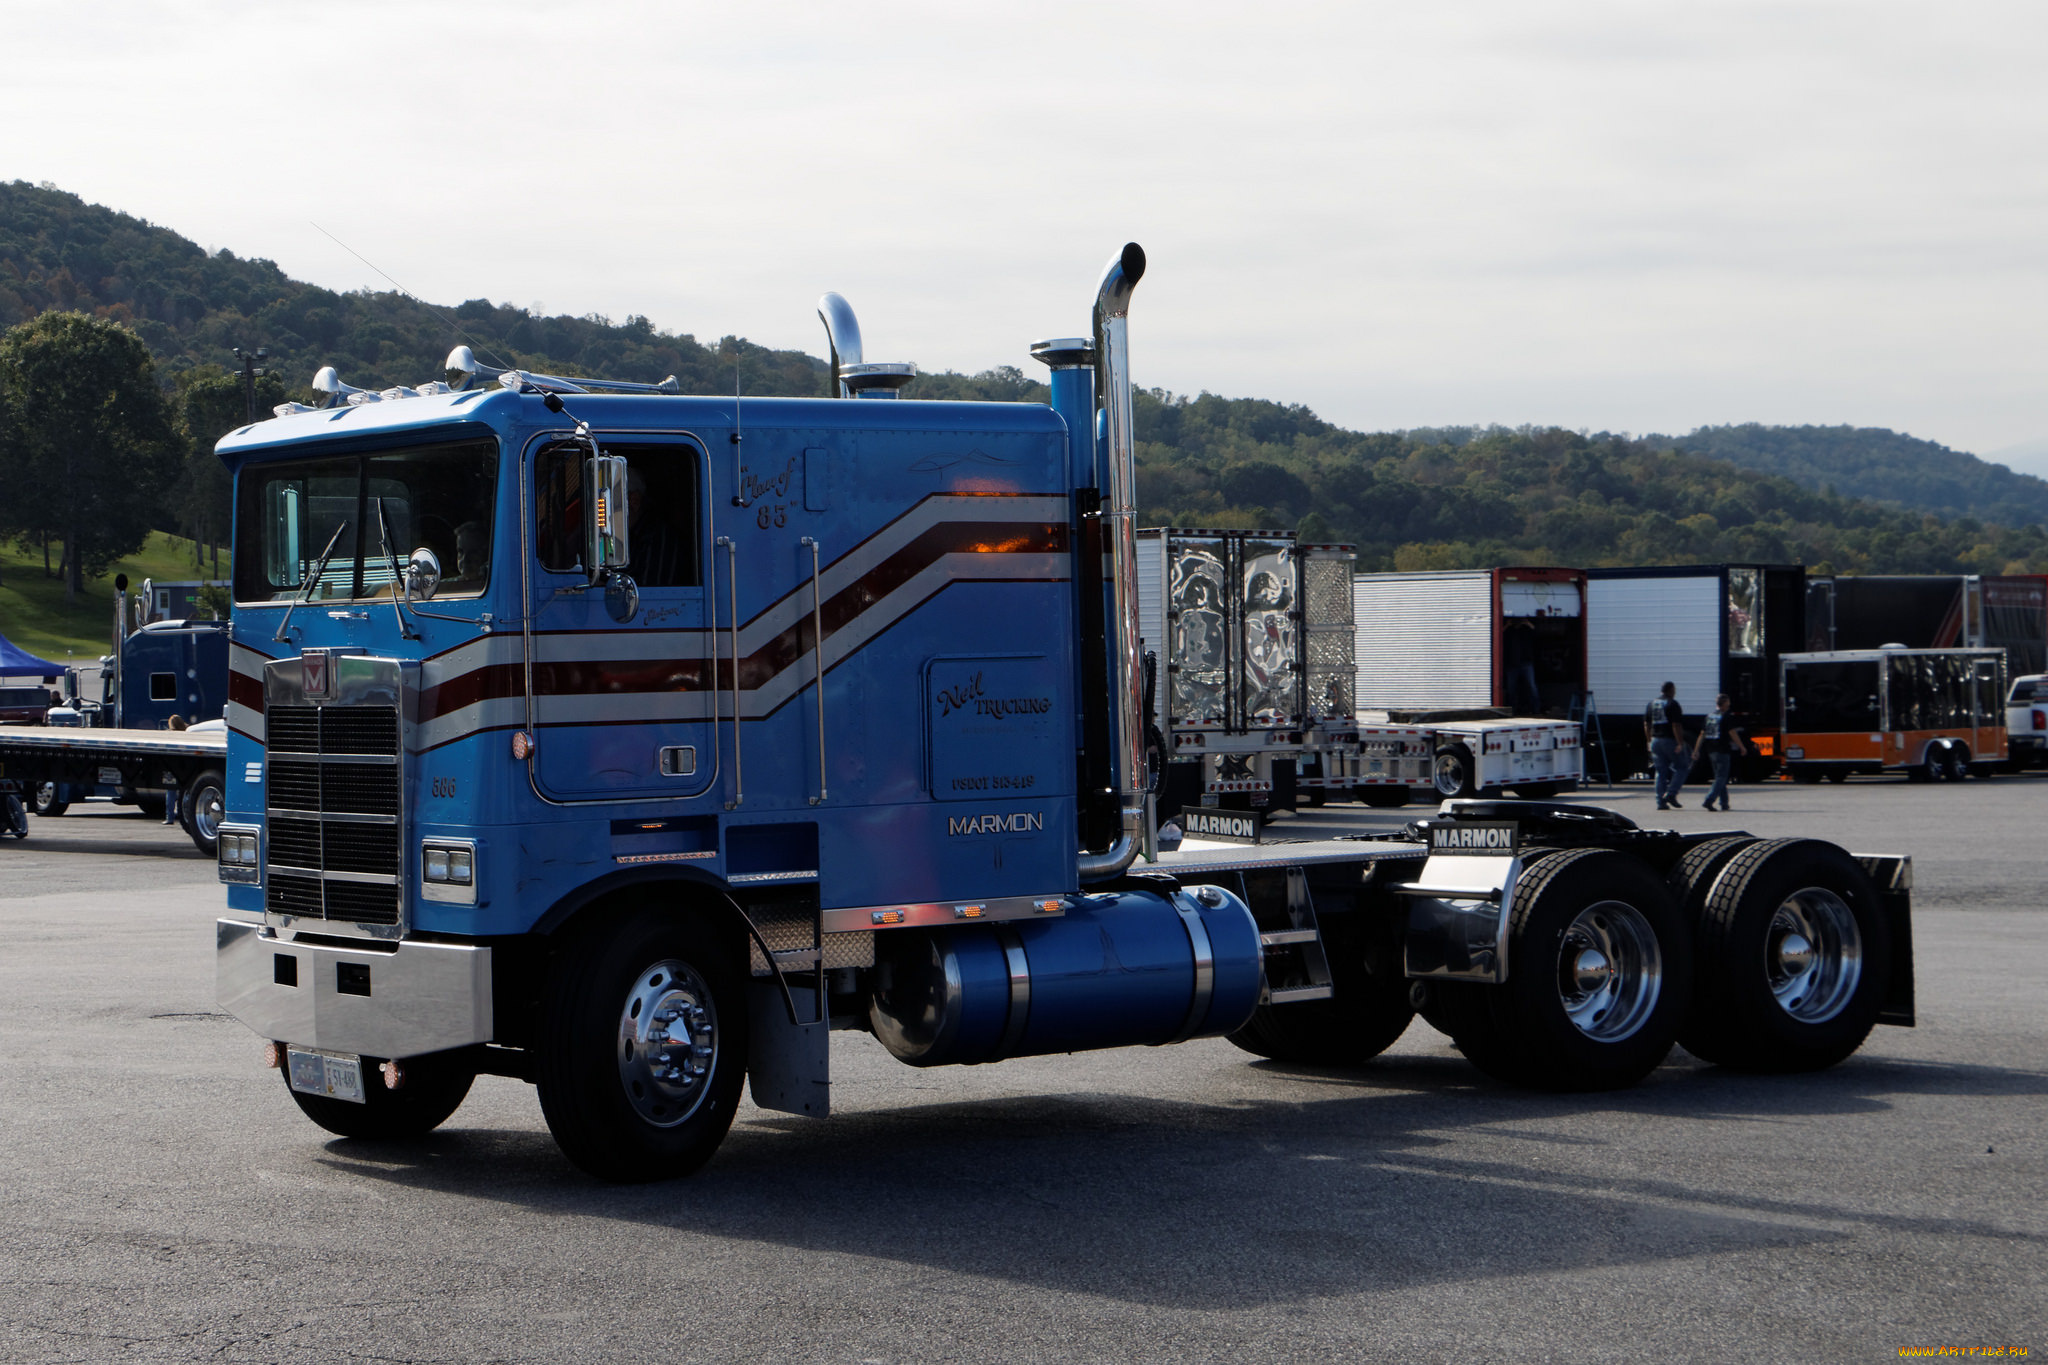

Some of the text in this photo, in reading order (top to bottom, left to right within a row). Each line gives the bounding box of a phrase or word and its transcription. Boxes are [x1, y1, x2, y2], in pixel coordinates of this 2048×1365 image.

[304, 666, 324, 690] M
[936, 670, 985, 717] Neil
[974, 697, 1052, 720] TRUCKING
[948, 811, 1043, 836] MARMON
[1186, 813, 1254, 837] MARMON
[1433, 828, 1511, 848] MARMON
